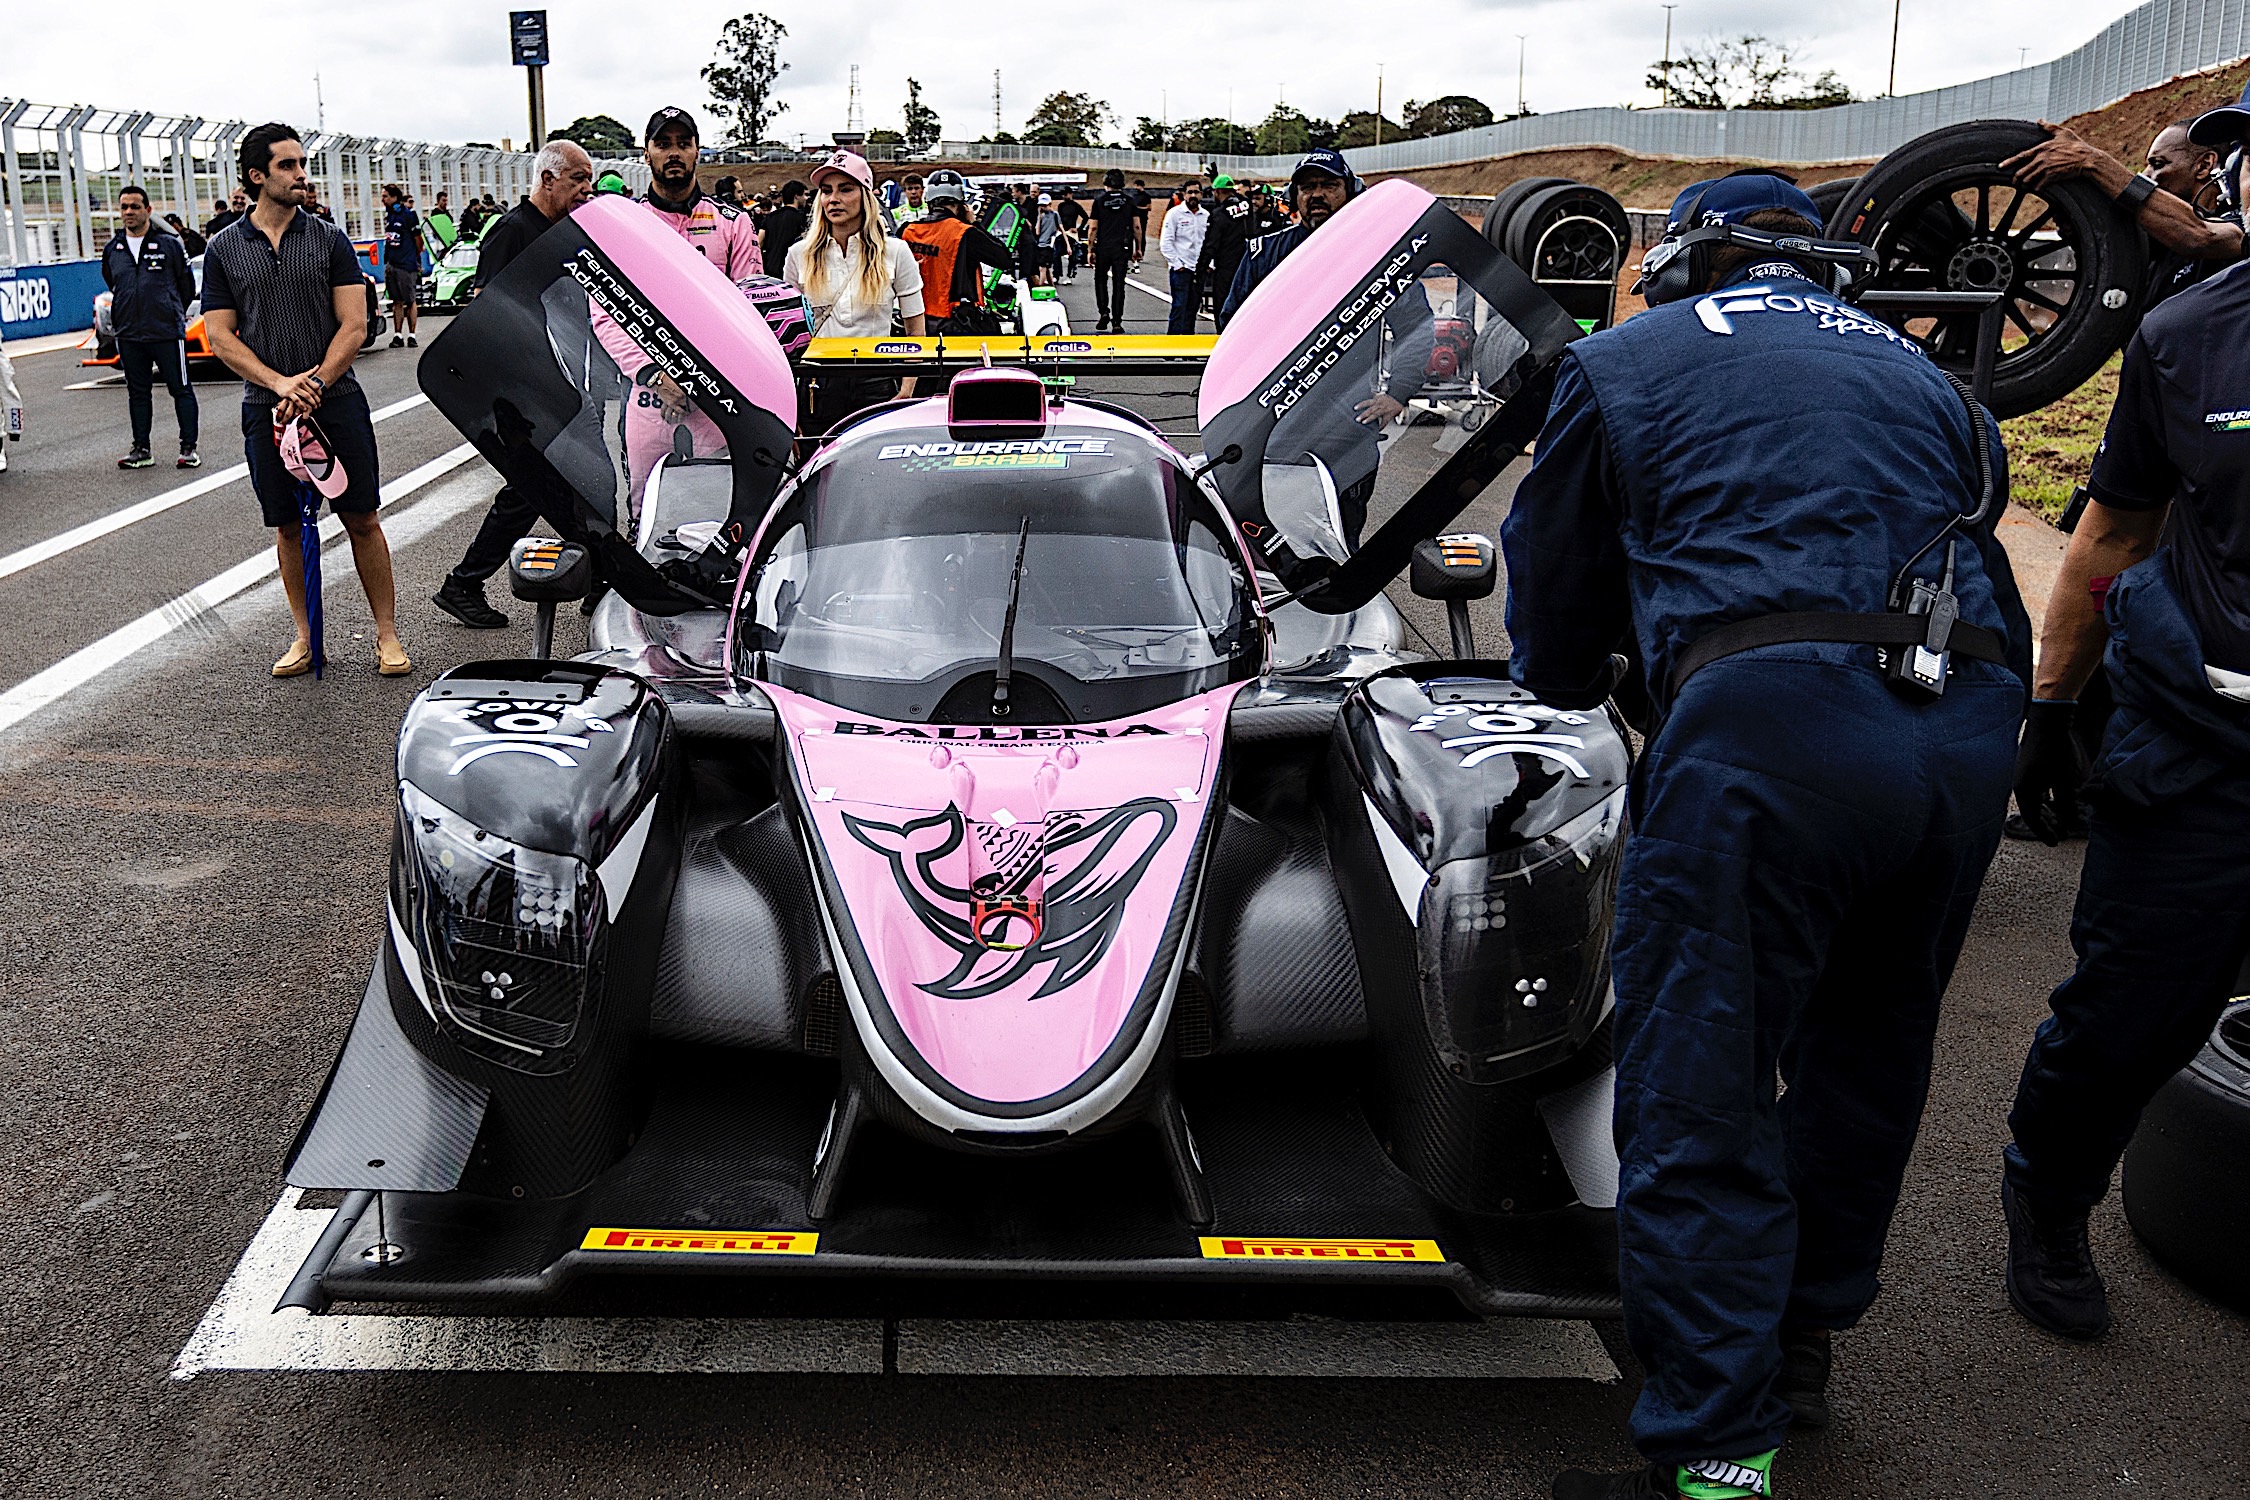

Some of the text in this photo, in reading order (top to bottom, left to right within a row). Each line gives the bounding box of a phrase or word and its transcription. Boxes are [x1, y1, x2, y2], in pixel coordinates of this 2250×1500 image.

[17, 278, 51, 321] BRB
[751, 290, 781, 300] BALLENA
[563, 261, 628, 324] Adriano
[626, 321, 684, 379] Buzaid
[577, 248, 655, 327] Fernando
[654, 326, 721, 397] Gorayeb
[1258, 323, 1341, 407] Fernando
[1338, 252, 1411, 324] Gorayeb
[877, 344, 919, 353] meli+
[1047, 343, 1089, 352] meli+
[1273, 351, 1339, 419] Adriano
[1336, 290, 1396, 351] Buzaid
[878, 440, 1108, 460] ENDURANCE
[952, 453, 1062, 467] BRASIL
[440, 701, 615, 733] MOVING
[1408, 703, 1591, 732] MOVING
[832, 720, 1173, 741] BALLENA
[899, 738, 975, 747] ORIGINAL
[1037, 739, 1105, 748] TEQUILA
[604, 1231, 796, 1250] PIRELLI
[1221, 1239, 1416, 1258] PIRELLI
